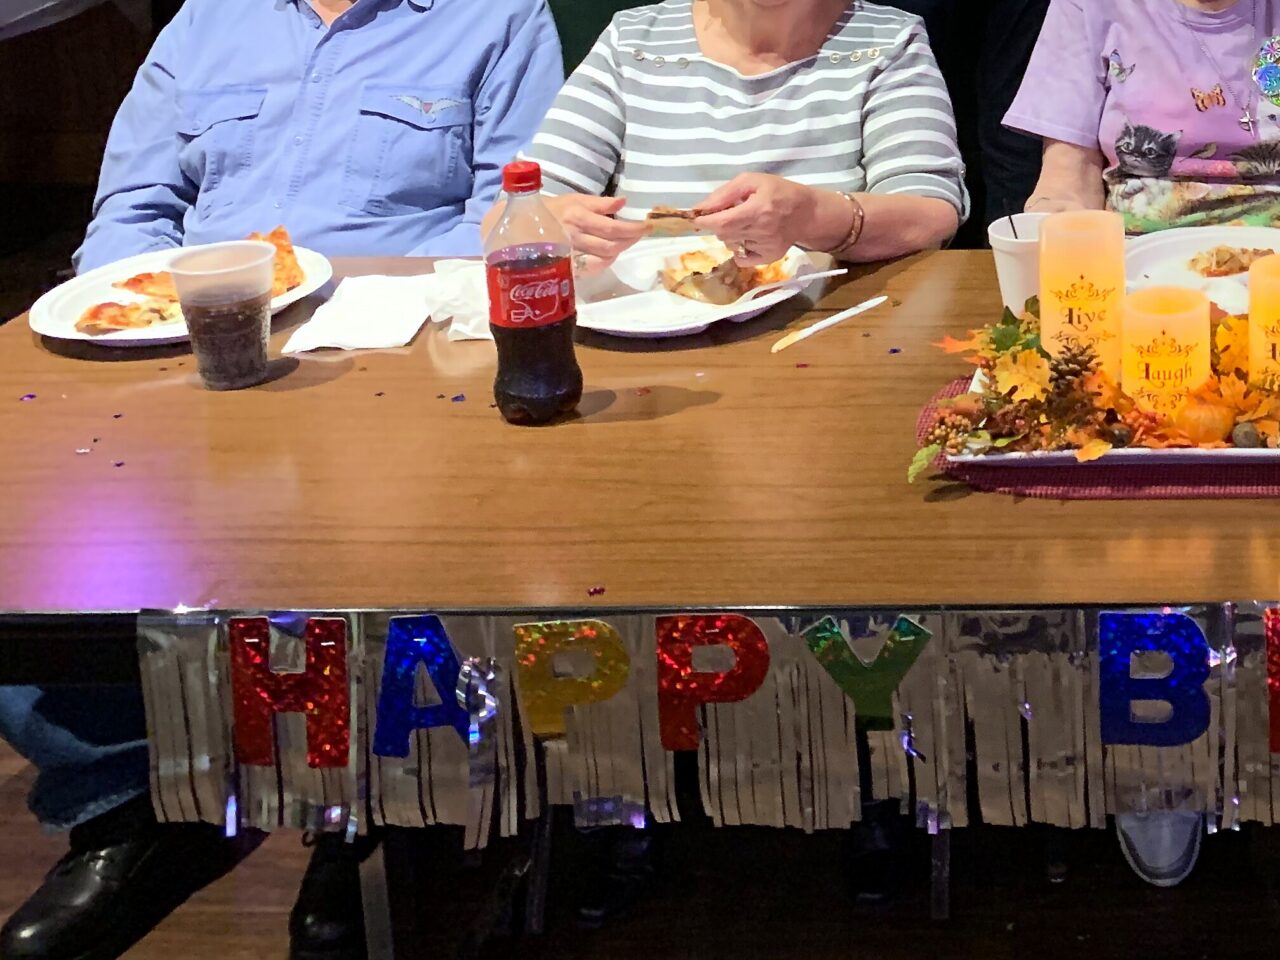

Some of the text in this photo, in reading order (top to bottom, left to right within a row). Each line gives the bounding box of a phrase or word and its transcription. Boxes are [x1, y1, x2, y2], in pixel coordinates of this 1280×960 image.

[511, 279, 559, 300] Coca-Cola
[1060, 306, 1107, 332] Live
[1137, 362, 1194, 391] Laugh
[229, 614, 932, 767] HAPPY
